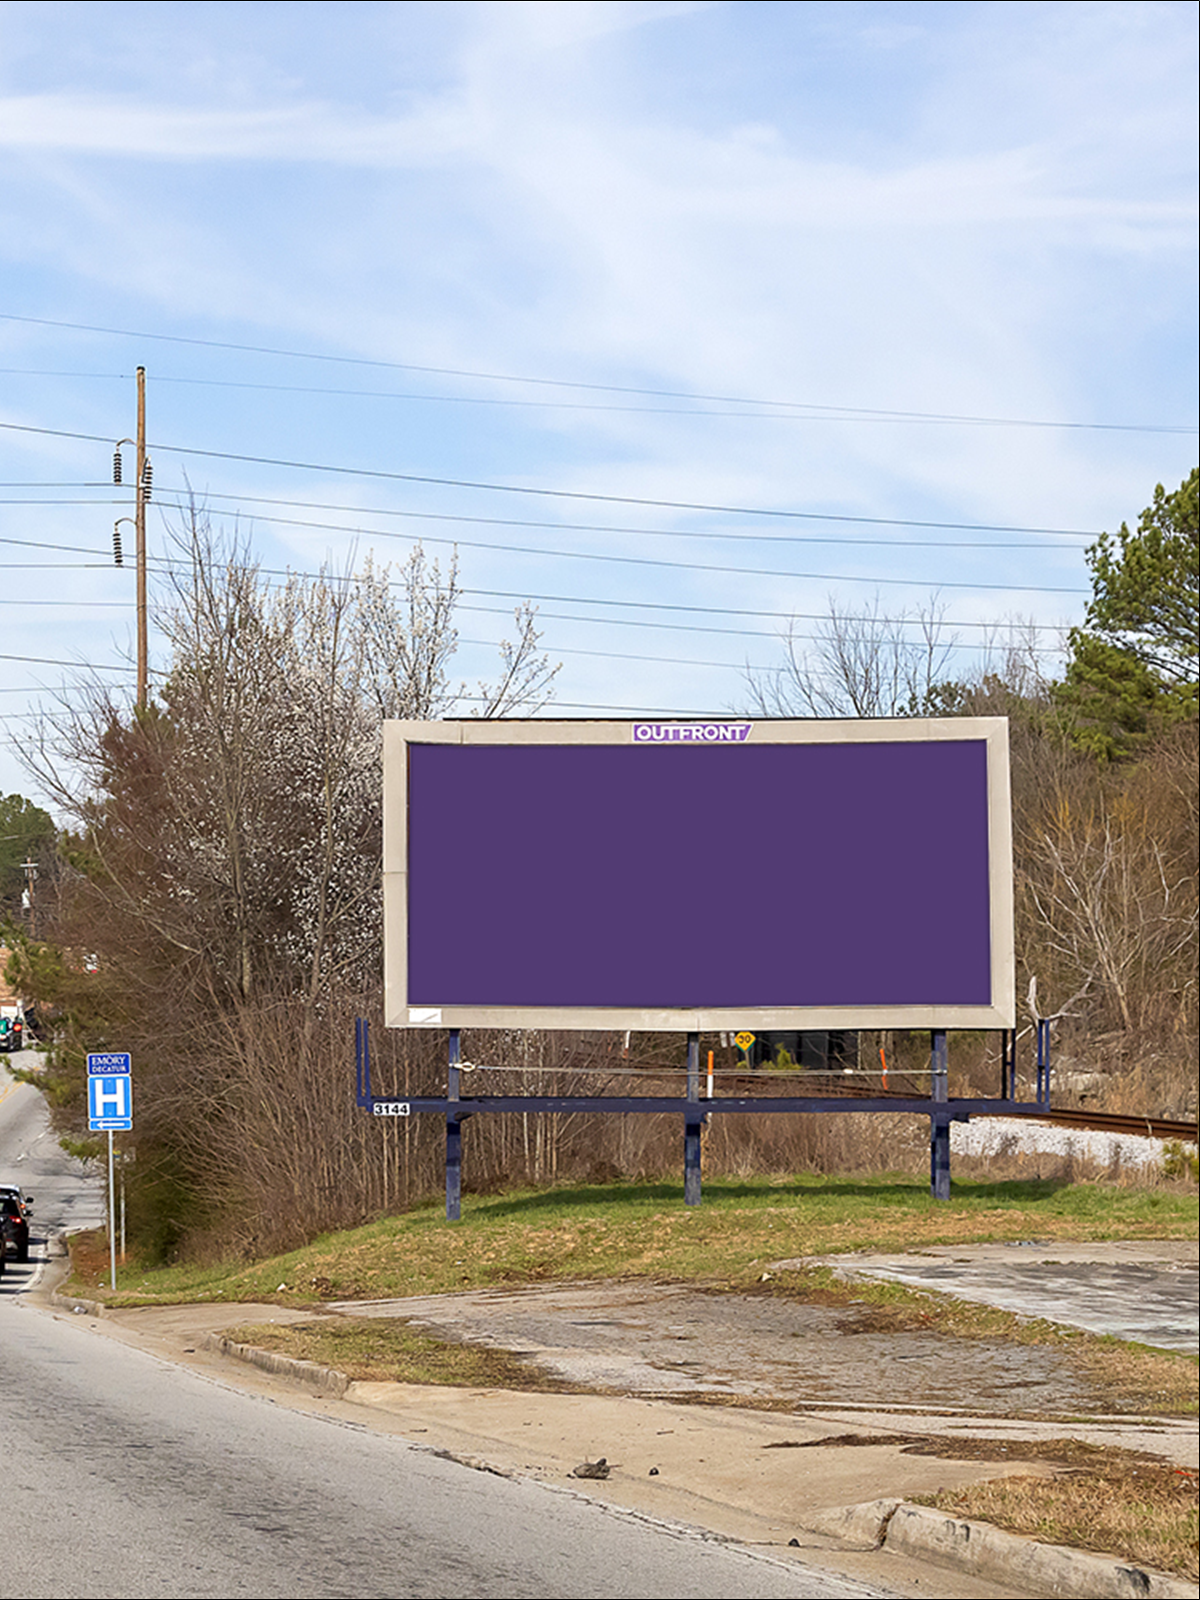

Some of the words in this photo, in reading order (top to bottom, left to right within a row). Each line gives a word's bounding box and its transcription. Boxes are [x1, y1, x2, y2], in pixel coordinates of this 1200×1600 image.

[636, 725, 746, 740] OUTFRONT
[92, 1055, 126, 1065] EMORY
[92, 1065, 127, 1073] DECATUR
[94, 1078, 126, 1117] H
[374, 1104, 409, 1115] 3144
